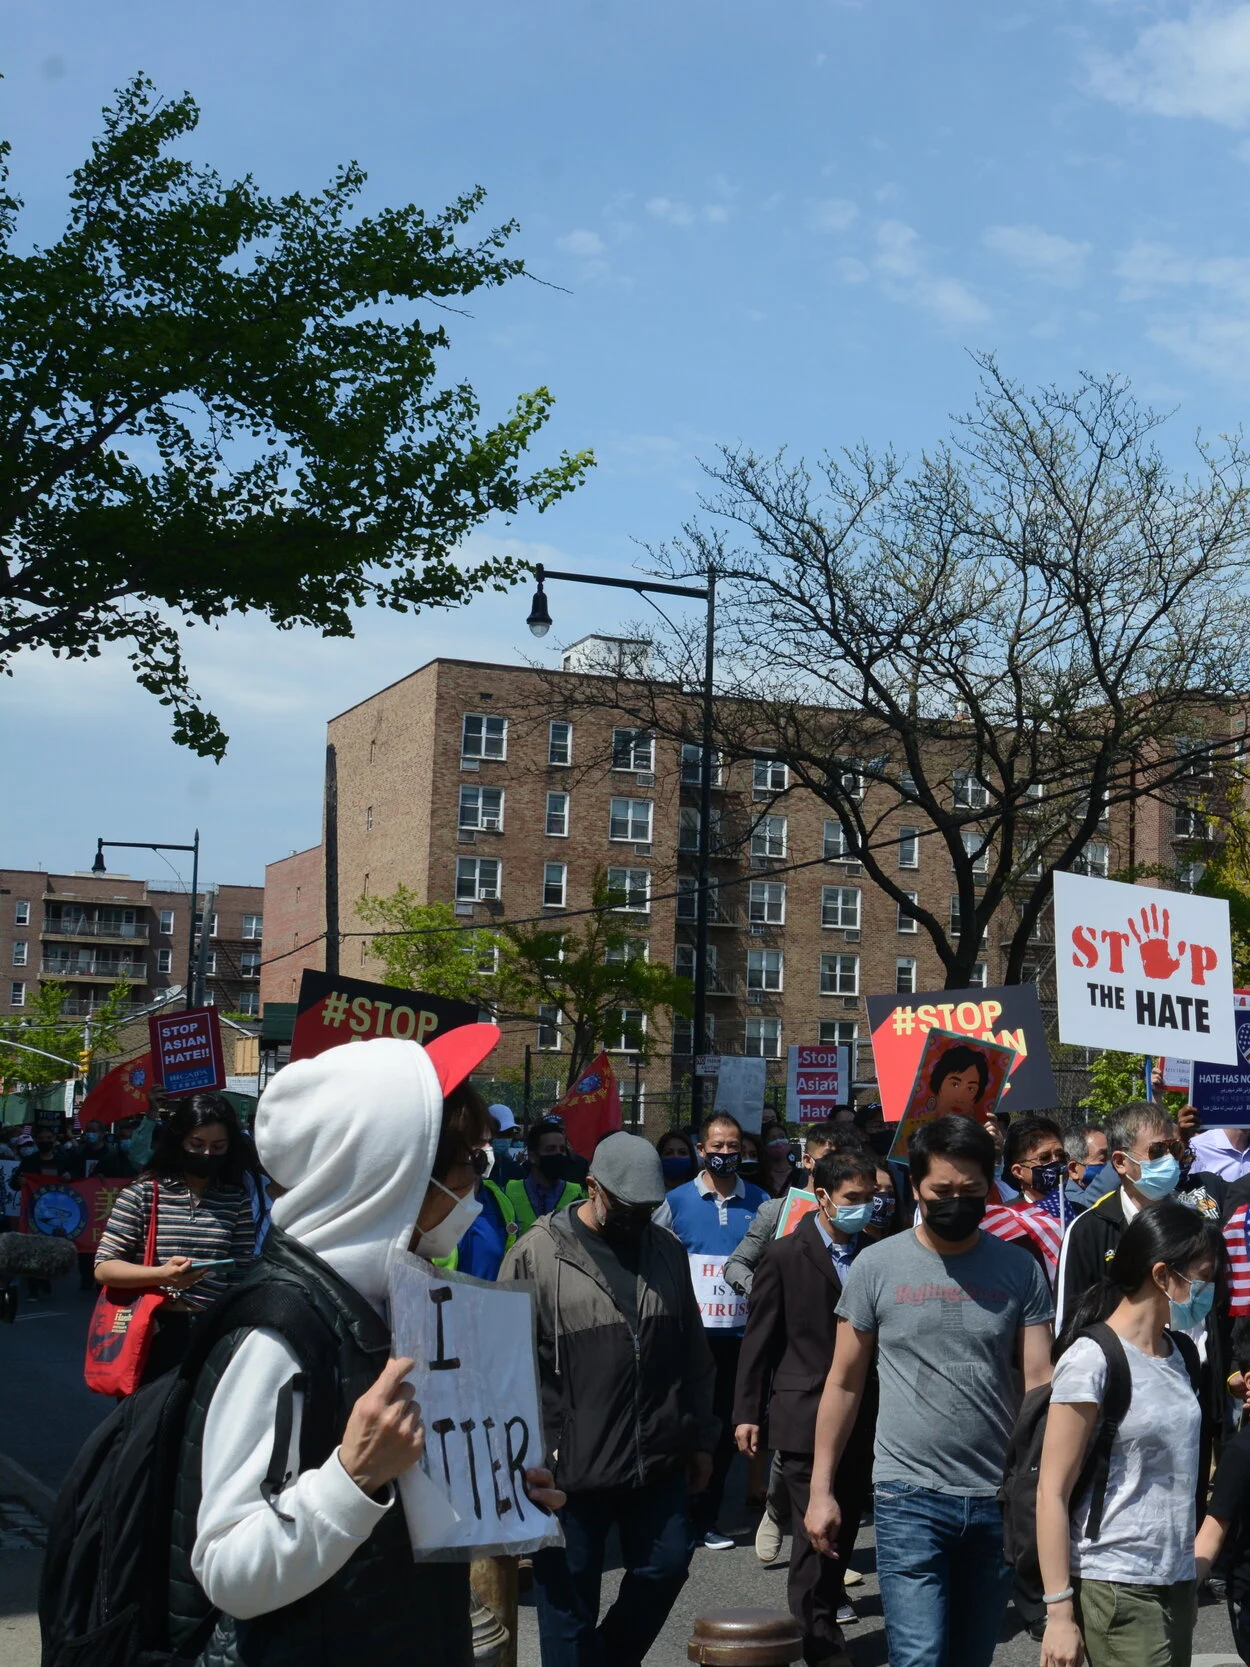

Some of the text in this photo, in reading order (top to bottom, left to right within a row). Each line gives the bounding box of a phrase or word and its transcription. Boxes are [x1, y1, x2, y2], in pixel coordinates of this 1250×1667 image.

[1087, 982, 1211, 1034] THE HATE
[321, 991, 439, 1045] #STOP
[892, 1000, 1003, 1036] #STOP
[162, 1022, 198, 1037] STOP
[163, 1035, 206, 1051] ASIAN
[164, 1048, 210, 1065] HATE!!
[797, 1079, 838, 1091] Asian
[1199, 1074, 1220, 1084] HATE
[1222, 1074, 1239, 1084] HAS
[713, 1285, 726, 1296] IS
[428, 1286, 461, 1371] I
